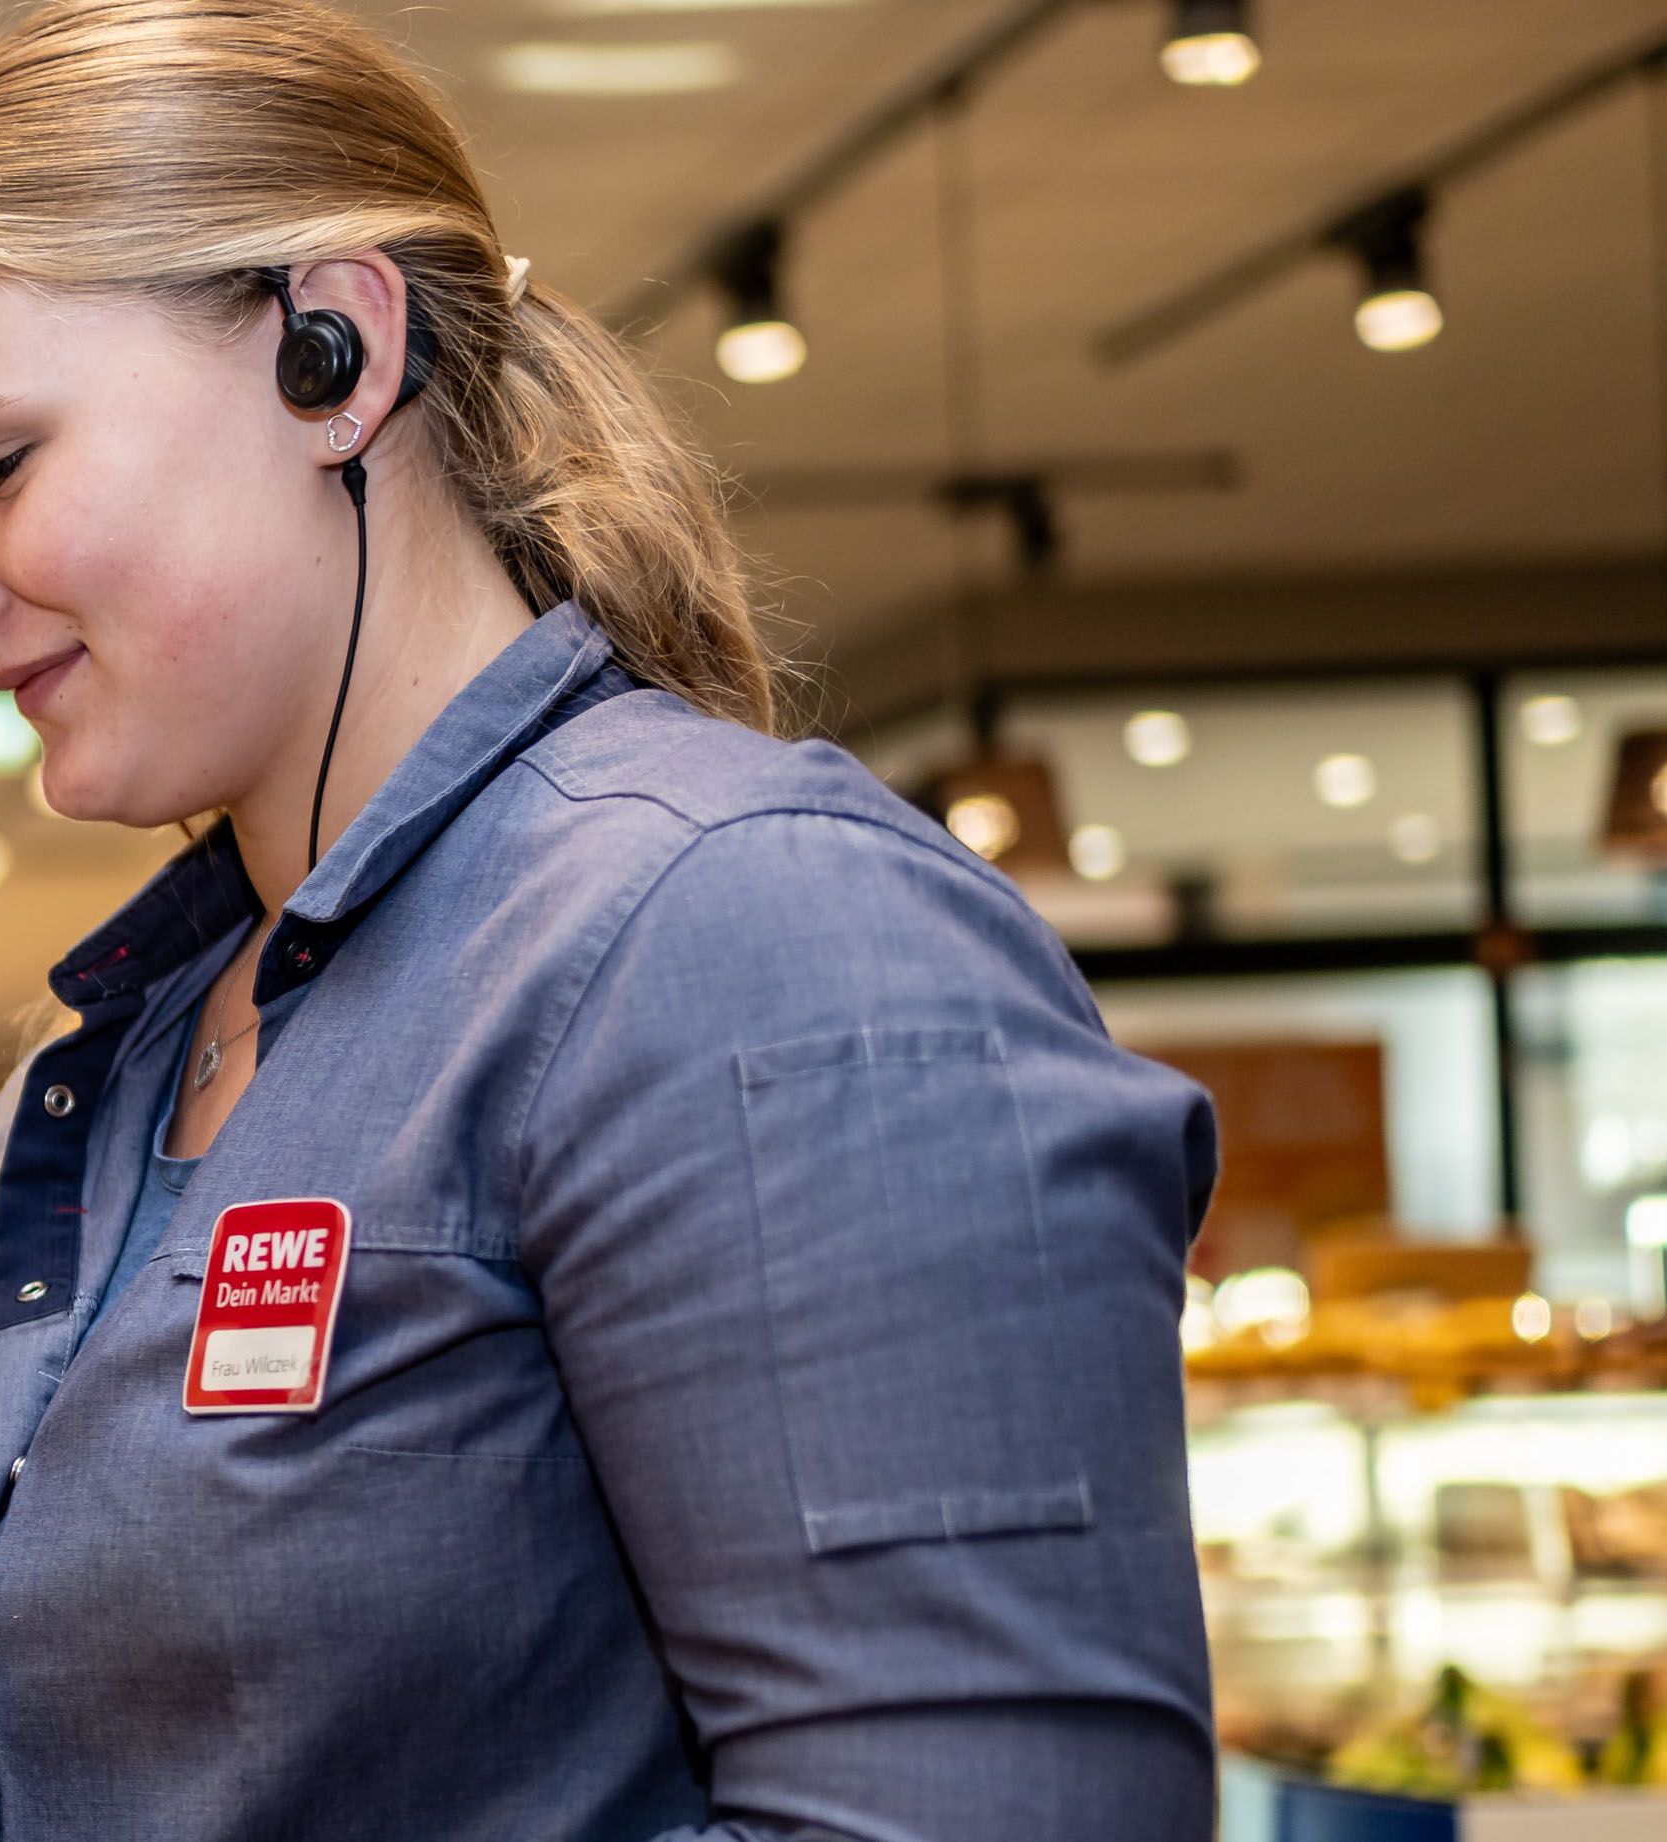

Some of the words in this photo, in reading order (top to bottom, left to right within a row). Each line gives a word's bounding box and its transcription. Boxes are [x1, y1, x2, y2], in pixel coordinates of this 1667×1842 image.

[222, 1228, 329, 1273] REWE
[216, 1282, 256, 1308] Dein
[260, 1278, 320, 1306] Markt
[211, 1360, 240, 1377] Frau
[245, 1356, 299, 1374] Wilczek
